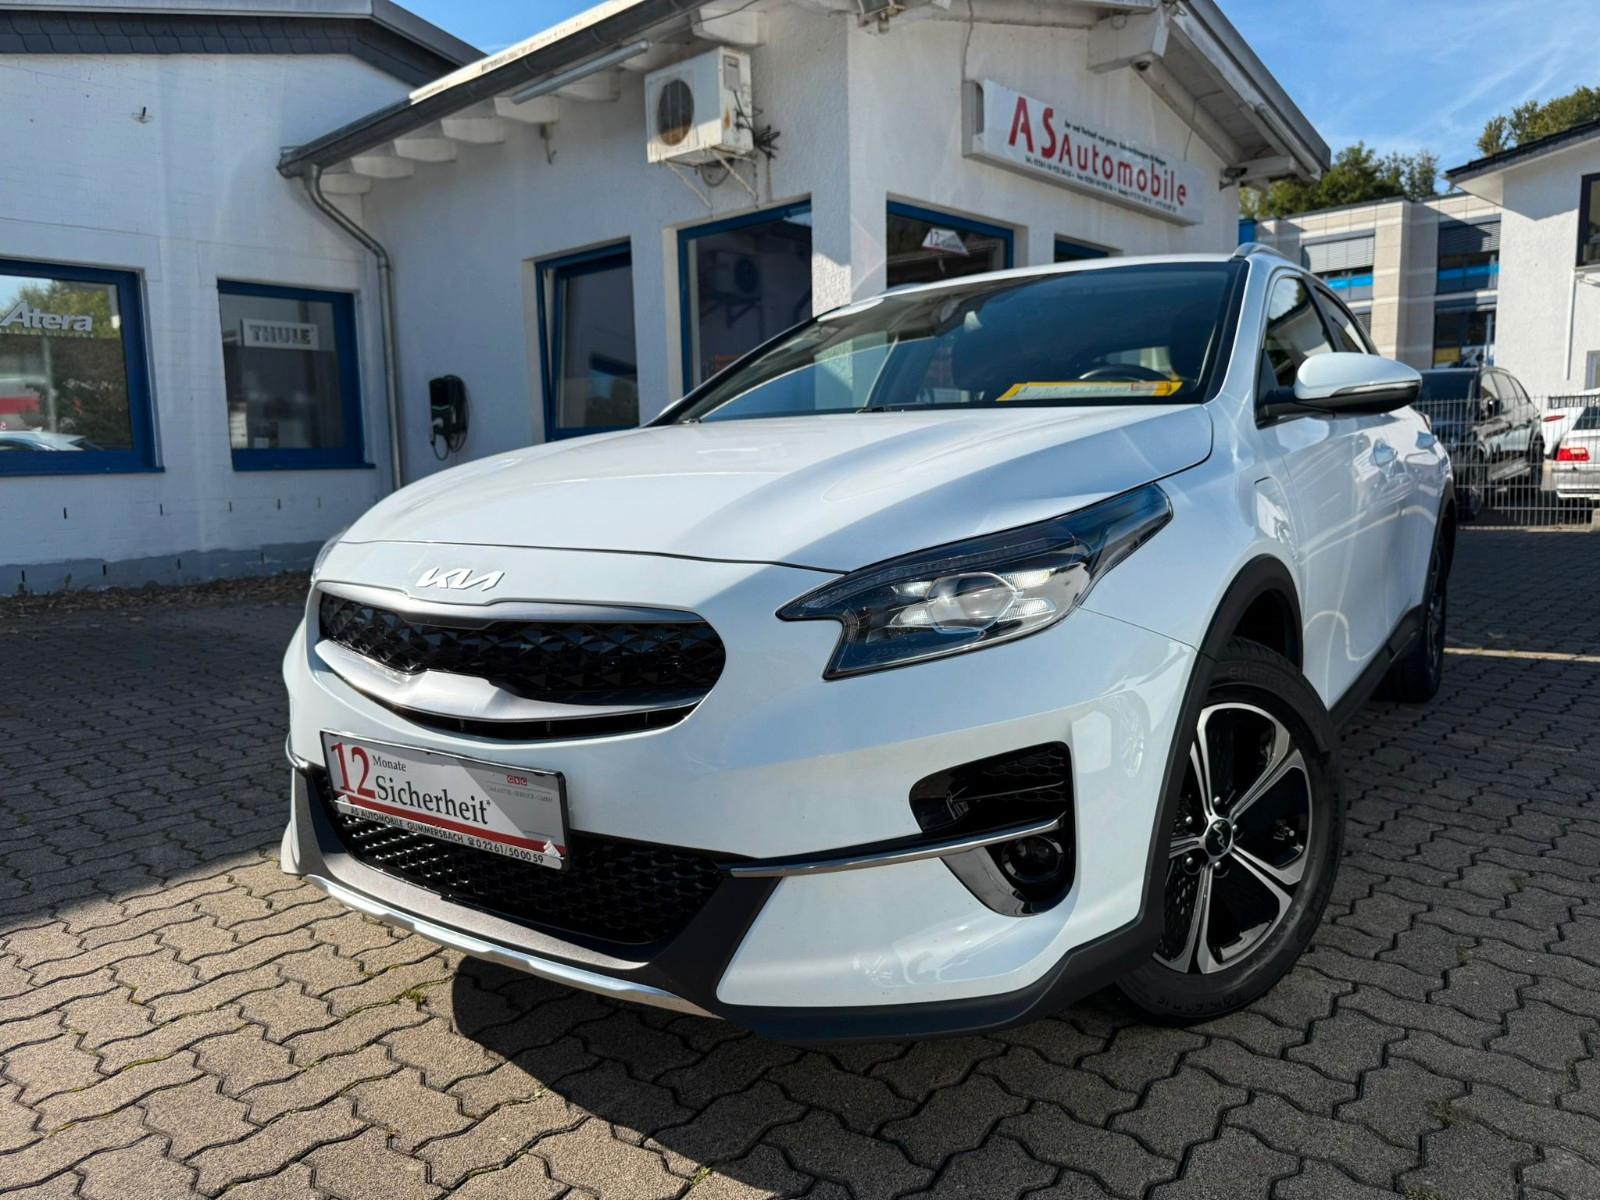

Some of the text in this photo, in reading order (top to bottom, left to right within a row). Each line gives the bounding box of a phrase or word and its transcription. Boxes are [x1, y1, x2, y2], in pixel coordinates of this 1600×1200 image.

[1059, 133, 1187, 207] Automobile
[0, 302, 93, 333] Atera
[248, 324, 312, 345] THULE
[416, 567, 505, 592] KIA
[330, 742, 376, 800] 12
[372, 755, 407, 773] Monate
[361, 808, 403, 827] AUTOMOBILE
[407, 822, 464, 844] GUMMERSBACH
